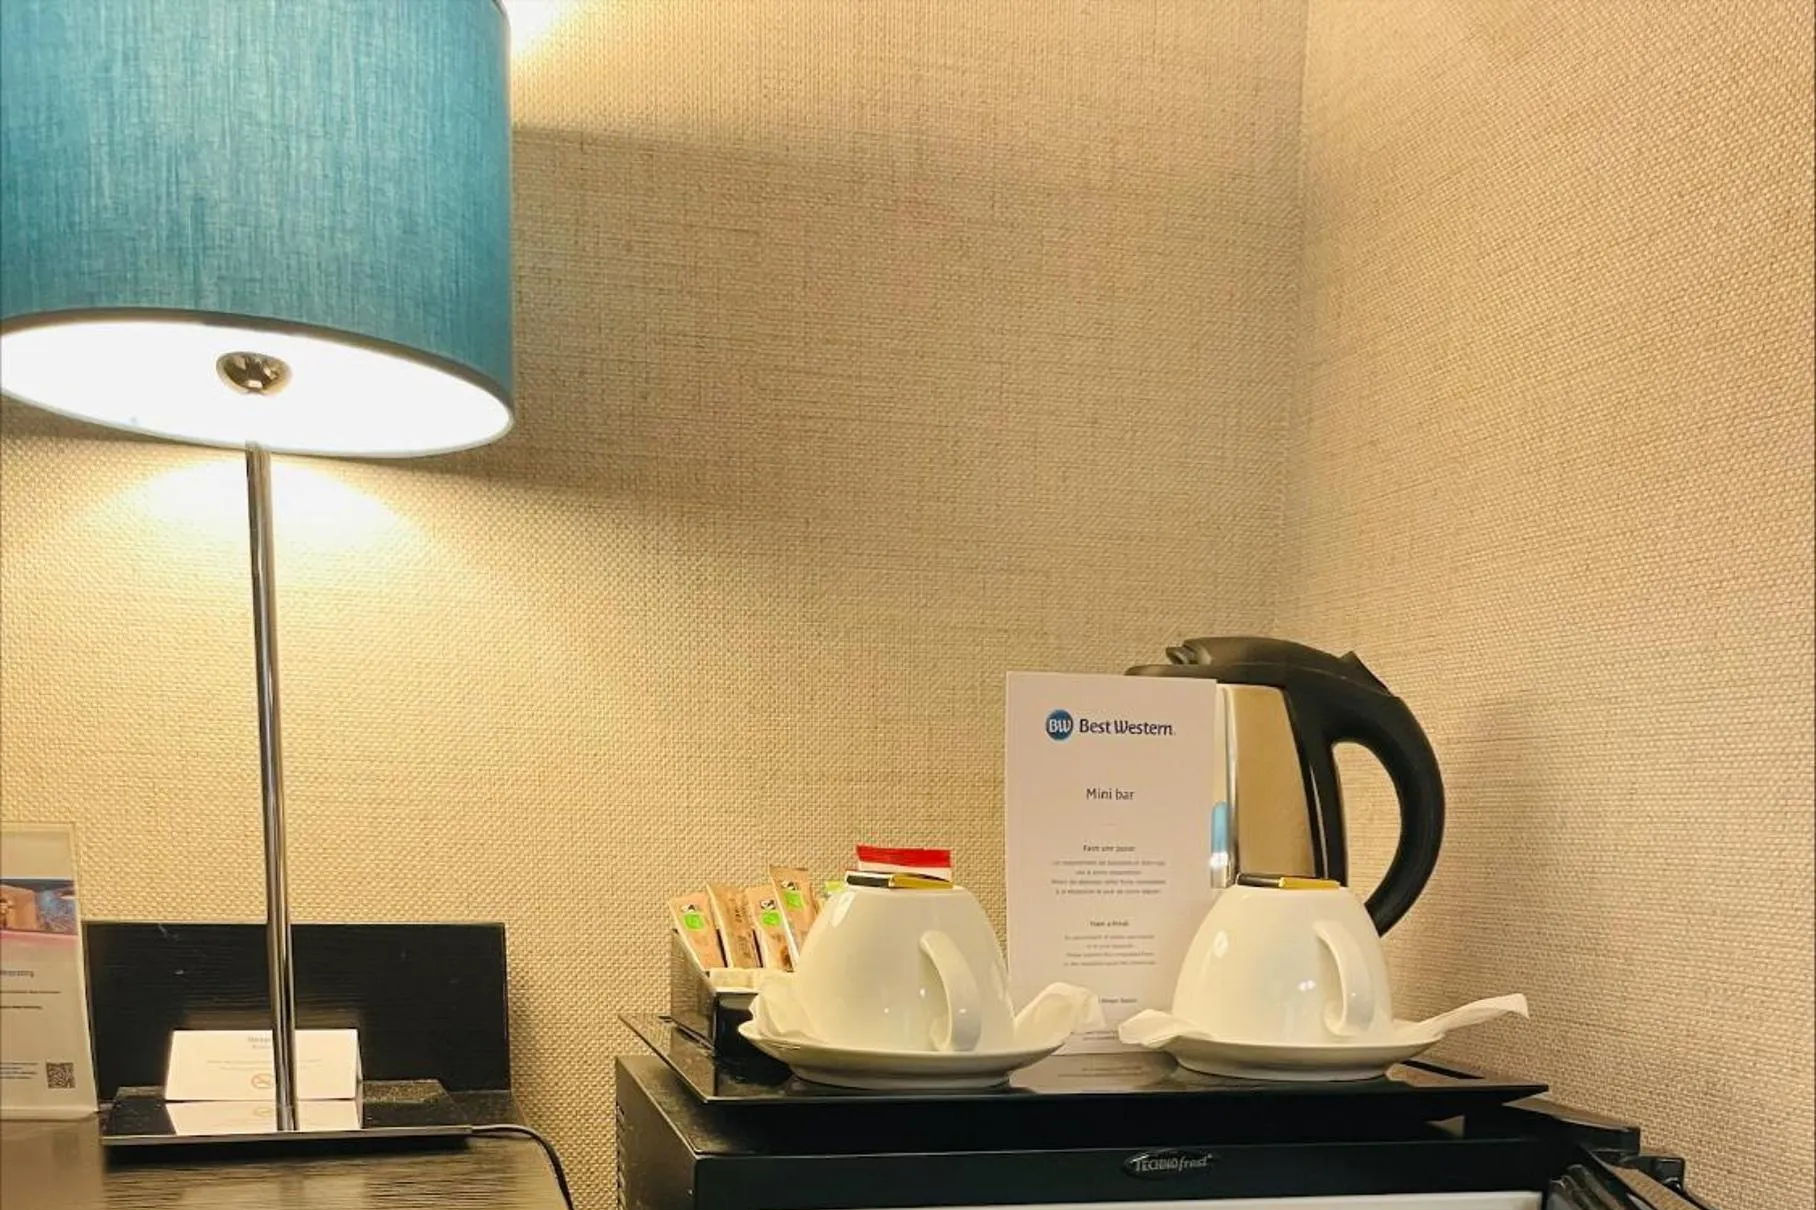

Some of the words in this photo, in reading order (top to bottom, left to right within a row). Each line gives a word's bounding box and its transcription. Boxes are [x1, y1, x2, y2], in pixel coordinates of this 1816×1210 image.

[1079, 718, 1111, 734] Best
[1114, 719, 1174, 736] Western
[1086, 787, 1112, 800] Mini
[1115, 787, 1135, 800] bar
